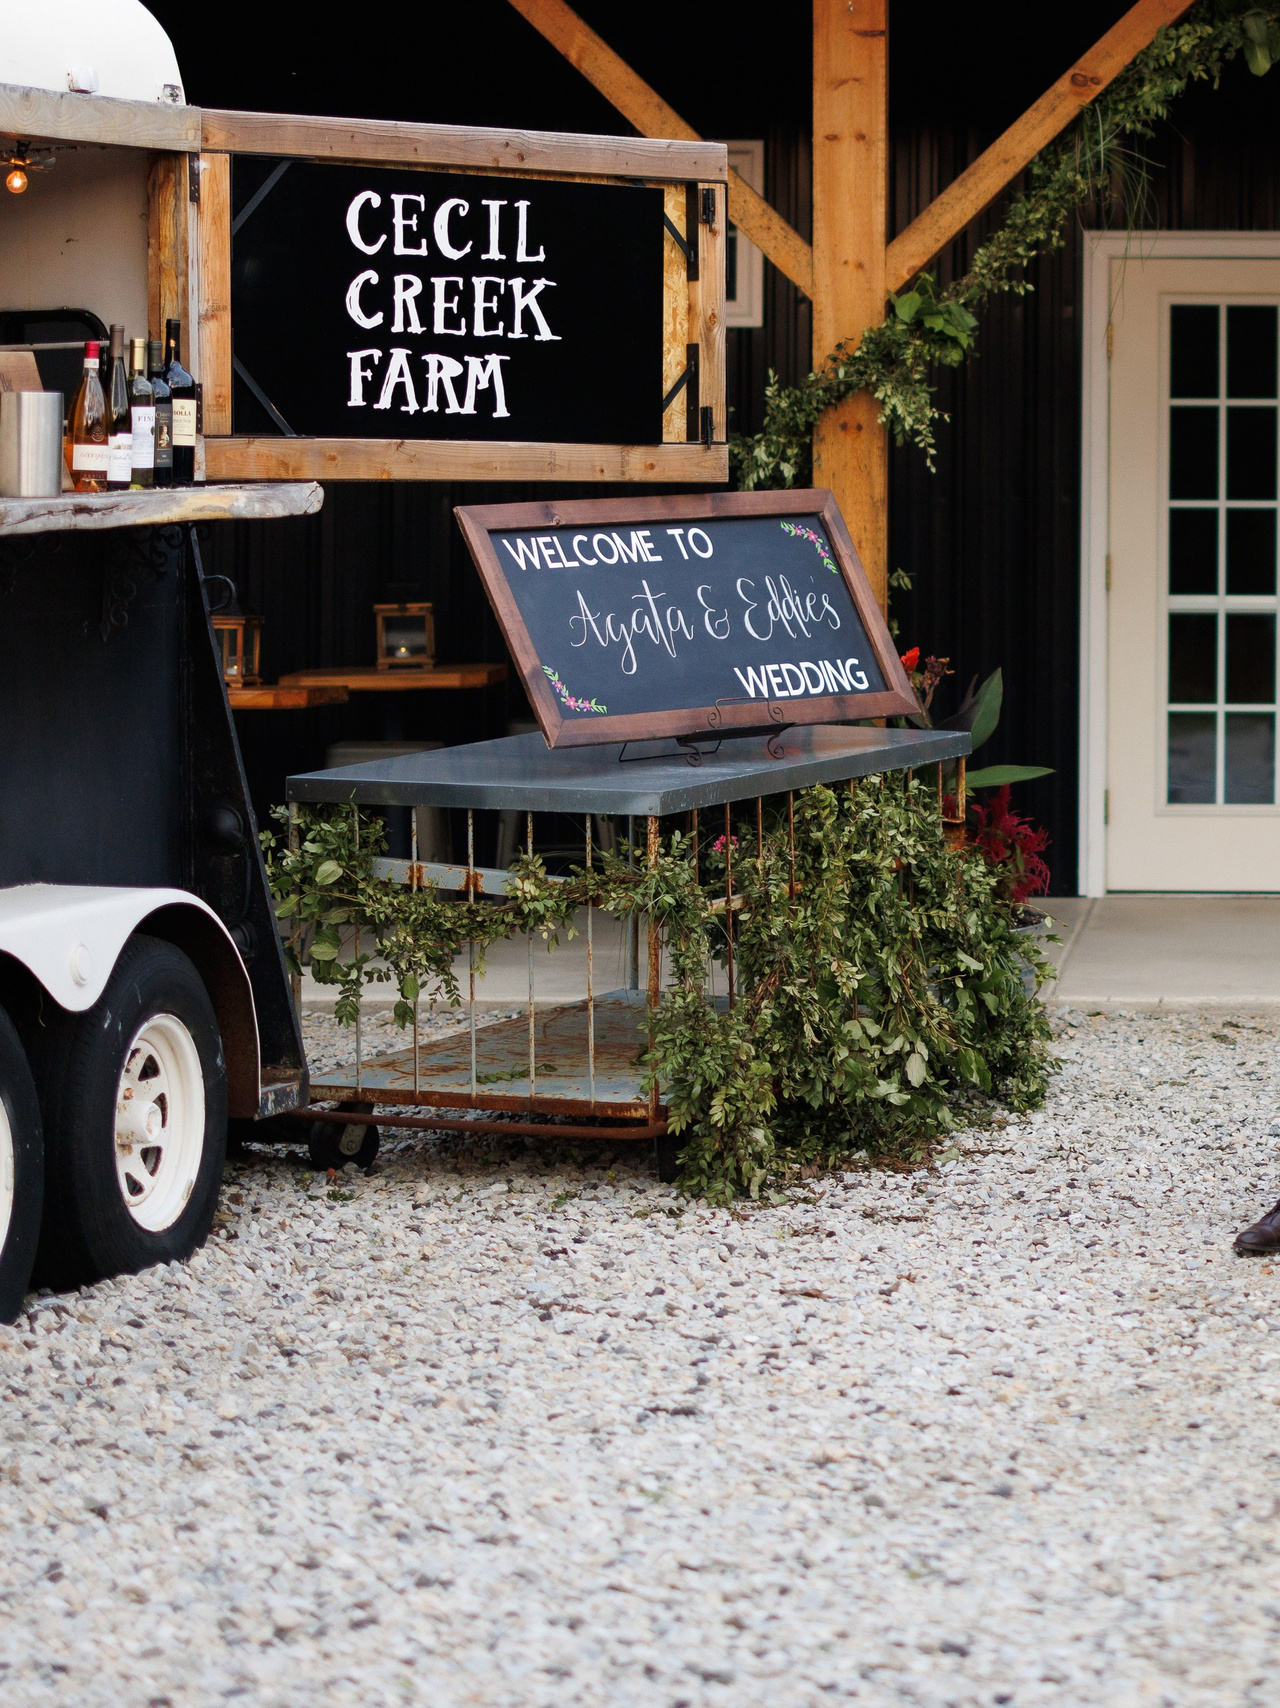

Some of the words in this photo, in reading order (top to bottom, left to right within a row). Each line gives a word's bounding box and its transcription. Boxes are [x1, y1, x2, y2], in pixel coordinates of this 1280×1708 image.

[346, 190, 546, 262] CECIL
[346, 270, 562, 341] CREEK
[346, 348, 511, 418] FARM
[502, 530, 662, 571] WELCOME
[667, 527, 713, 560] TO
[569, 579, 695, 675] Agata
[699, 584, 730, 640] &
[736, 574, 841, 641] Eddie's
[733, 658, 869, 698] WEDDING
